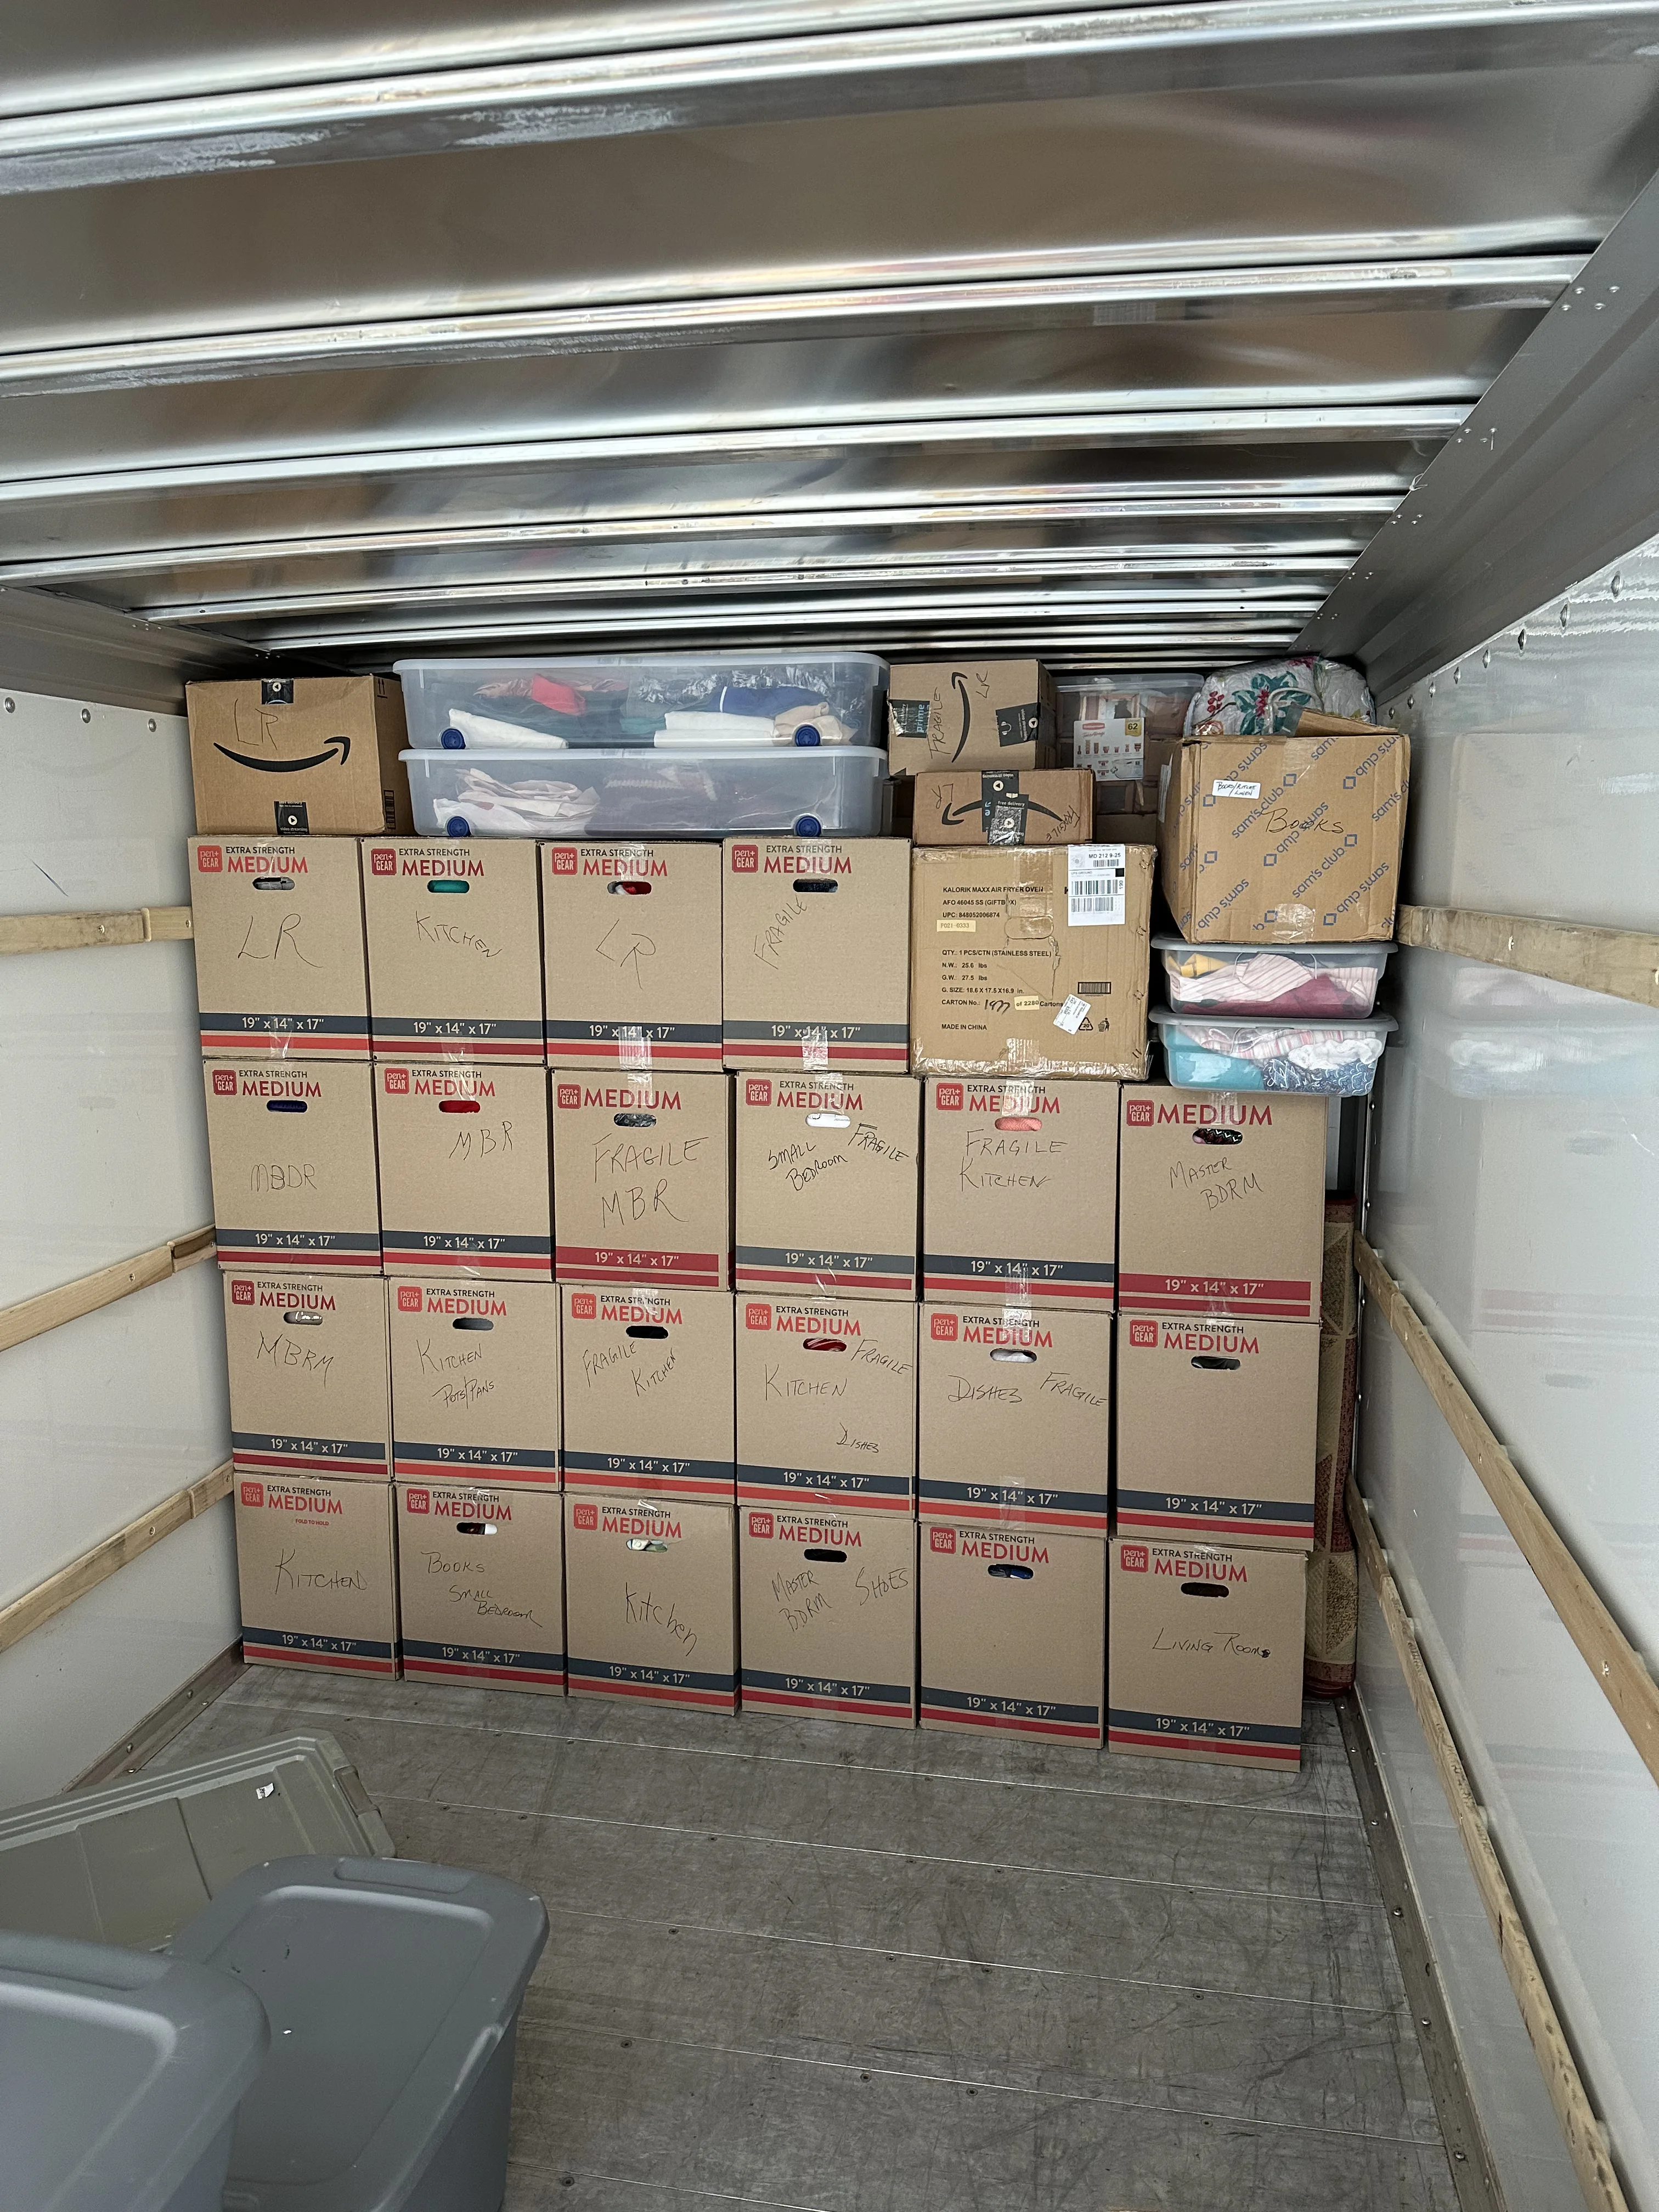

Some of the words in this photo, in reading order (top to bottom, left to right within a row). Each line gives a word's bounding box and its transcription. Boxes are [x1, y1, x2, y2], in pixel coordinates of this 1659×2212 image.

[234, 698, 279, 750] LR
[916, 704, 925, 733] prime
[1238, 742, 1267, 771] sam's
[1356, 753, 1379, 776] club
[1232, 809, 1262, 838] sam's
[1260, 787, 1284, 810] club
[1372, 792, 1402, 822] sam's
[1277, 831, 1300, 853] club
[228, 856, 307, 873] MEDIUM
[376, 860, 393, 871] GEAR
[403, 860, 483, 876] MEDIUM
[584, 859, 667, 876] MEDIUM
[765, 857, 851, 873] MEDIUM
[1293, 868, 1323, 898] sam's
[1322, 847, 1345, 870] club
[1359, 862, 1389, 892] sam's
[1220, 879, 1249, 908] sam's
[1336, 890, 1360, 913] club
[1198, 906, 1221, 928] club
[238, 913, 323, 968] LR
[754, 895, 807, 969] FRAGILE
[596, 919, 656, 989] LR
[243, 1081, 320, 1097] MEDIUM
[415, 1080, 495, 1096] MEDIUM
[585, 1089, 680, 1109] MEDIUM
[777, 1092, 862, 1110] MEDIUM
[1158, 1104, 1272, 1125] MEDIUM
[449, 1121, 512, 1160] MBR
[846, 1122, 910, 1161] FRAGILE
[966, 1128, 1069, 1155] FRAGILE
[592, 1133, 709, 1187] FRAGILE
[602, 1178, 689, 1228] MBR
[260, 1293, 335, 1310] MEDIUM
[453, 1289, 494, 1297] STRENGTH
[427, 1298, 506, 1316] MEDIUM
[602, 1305, 682, 1324] MEDIUM
[777, 1316, 860, 1335] MEDIUM
[1163, 1322, 1192, 1331] EXTRA
[1194, 1324, 1243, 1334] STRENGTH
[963, 1327, 1052, 1347] MEDIUM
[1165, 1334, 1259, 1353] MEDIUM
[257, 1331, 334, 1388] MBRM
[582, 1341, 637, 1387] FRAGILE
[851, 1339, 912, 1375] FRAGILE
[1040, 1372, 1107, 1406] FRAGILE
[268, 1485, 290, 1493] EXTRA
[292, 1487, 331, 1496] STRENGTH
[269, 1494, 342, 1514] MEDIUM
[435, 1502, 511, 1520] MEDIUM
[603, 1517, 681, 1538] MEDIUM
[780, 1525, 861, 1546] MEDIUM
[962, 1541, 1048, 1562] MEDIUM
[1155, 1559, 1246, 1582] MEDIUM
[967, 1697, 986, 1707] 19"
[1002, 1701, 1022, 1712] 14"
[1037, 1705, 1056, 1716] 17"
